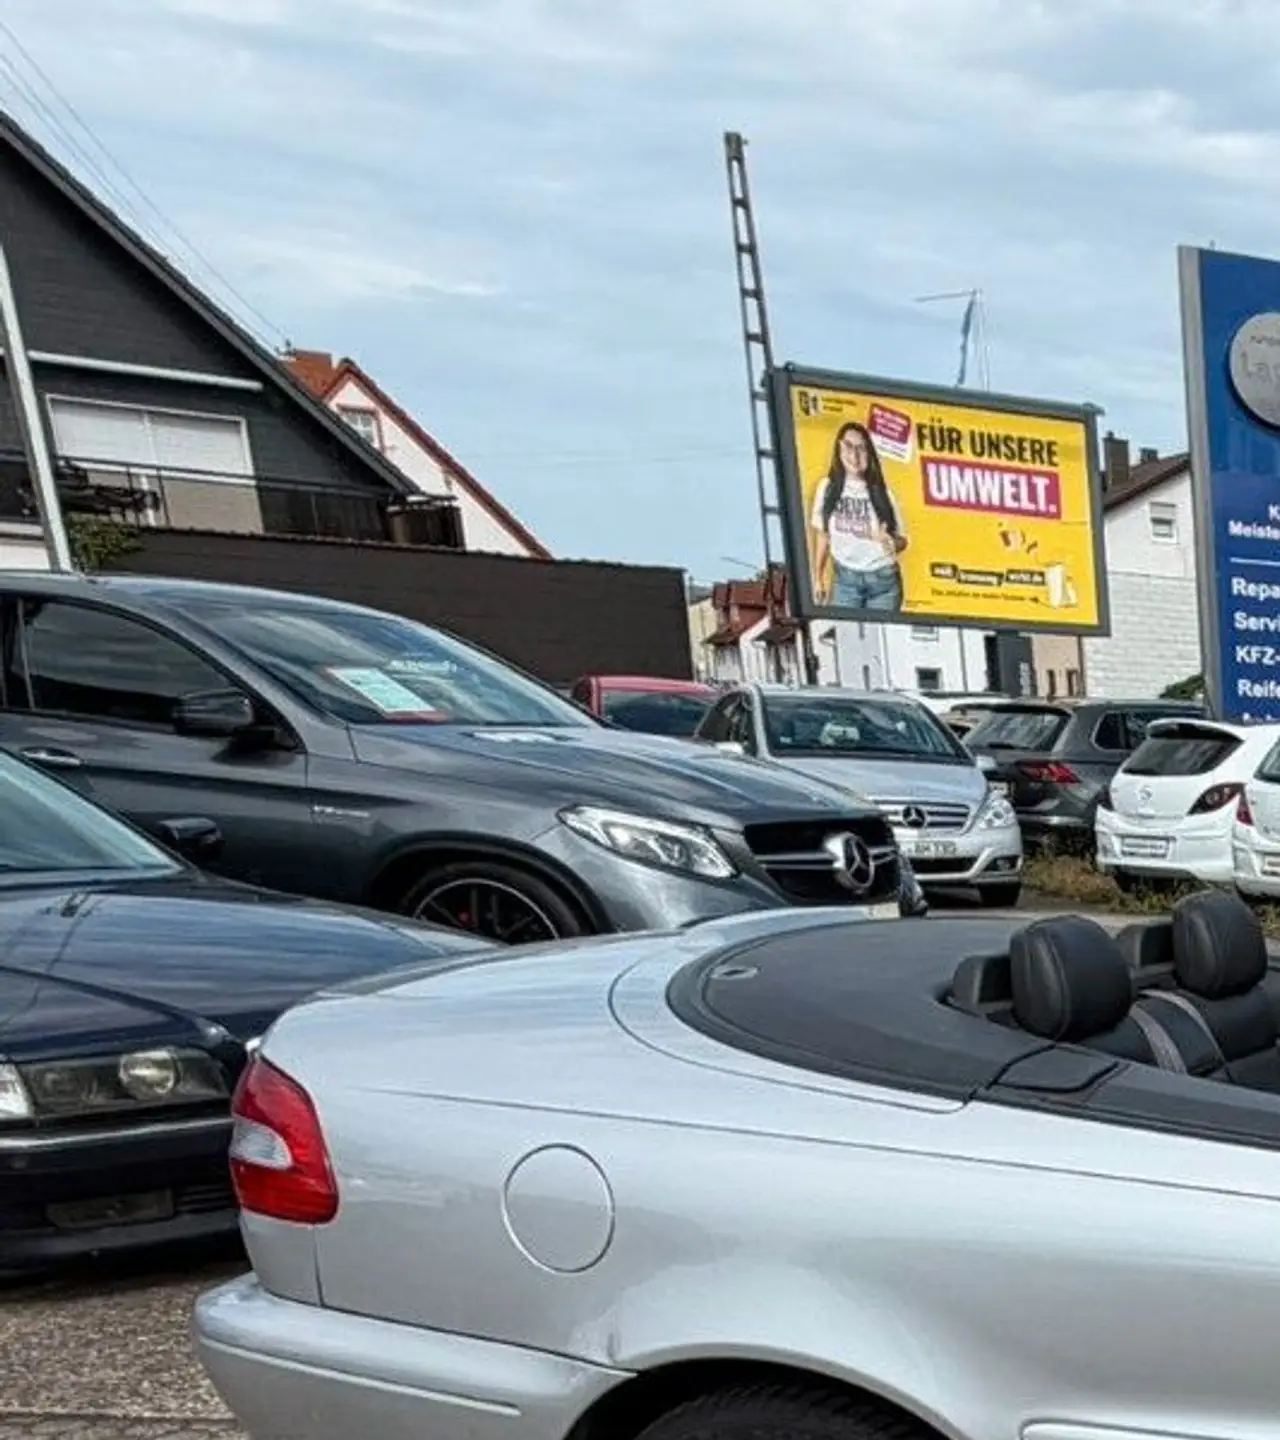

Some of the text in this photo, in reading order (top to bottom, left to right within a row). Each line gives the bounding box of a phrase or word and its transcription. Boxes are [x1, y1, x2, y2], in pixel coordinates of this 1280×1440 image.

[917, 417, 963, 455] FÜR
[971, 431, 1058, 466] UNSERE
[926, 463, 1057, 513] UMWELT.
